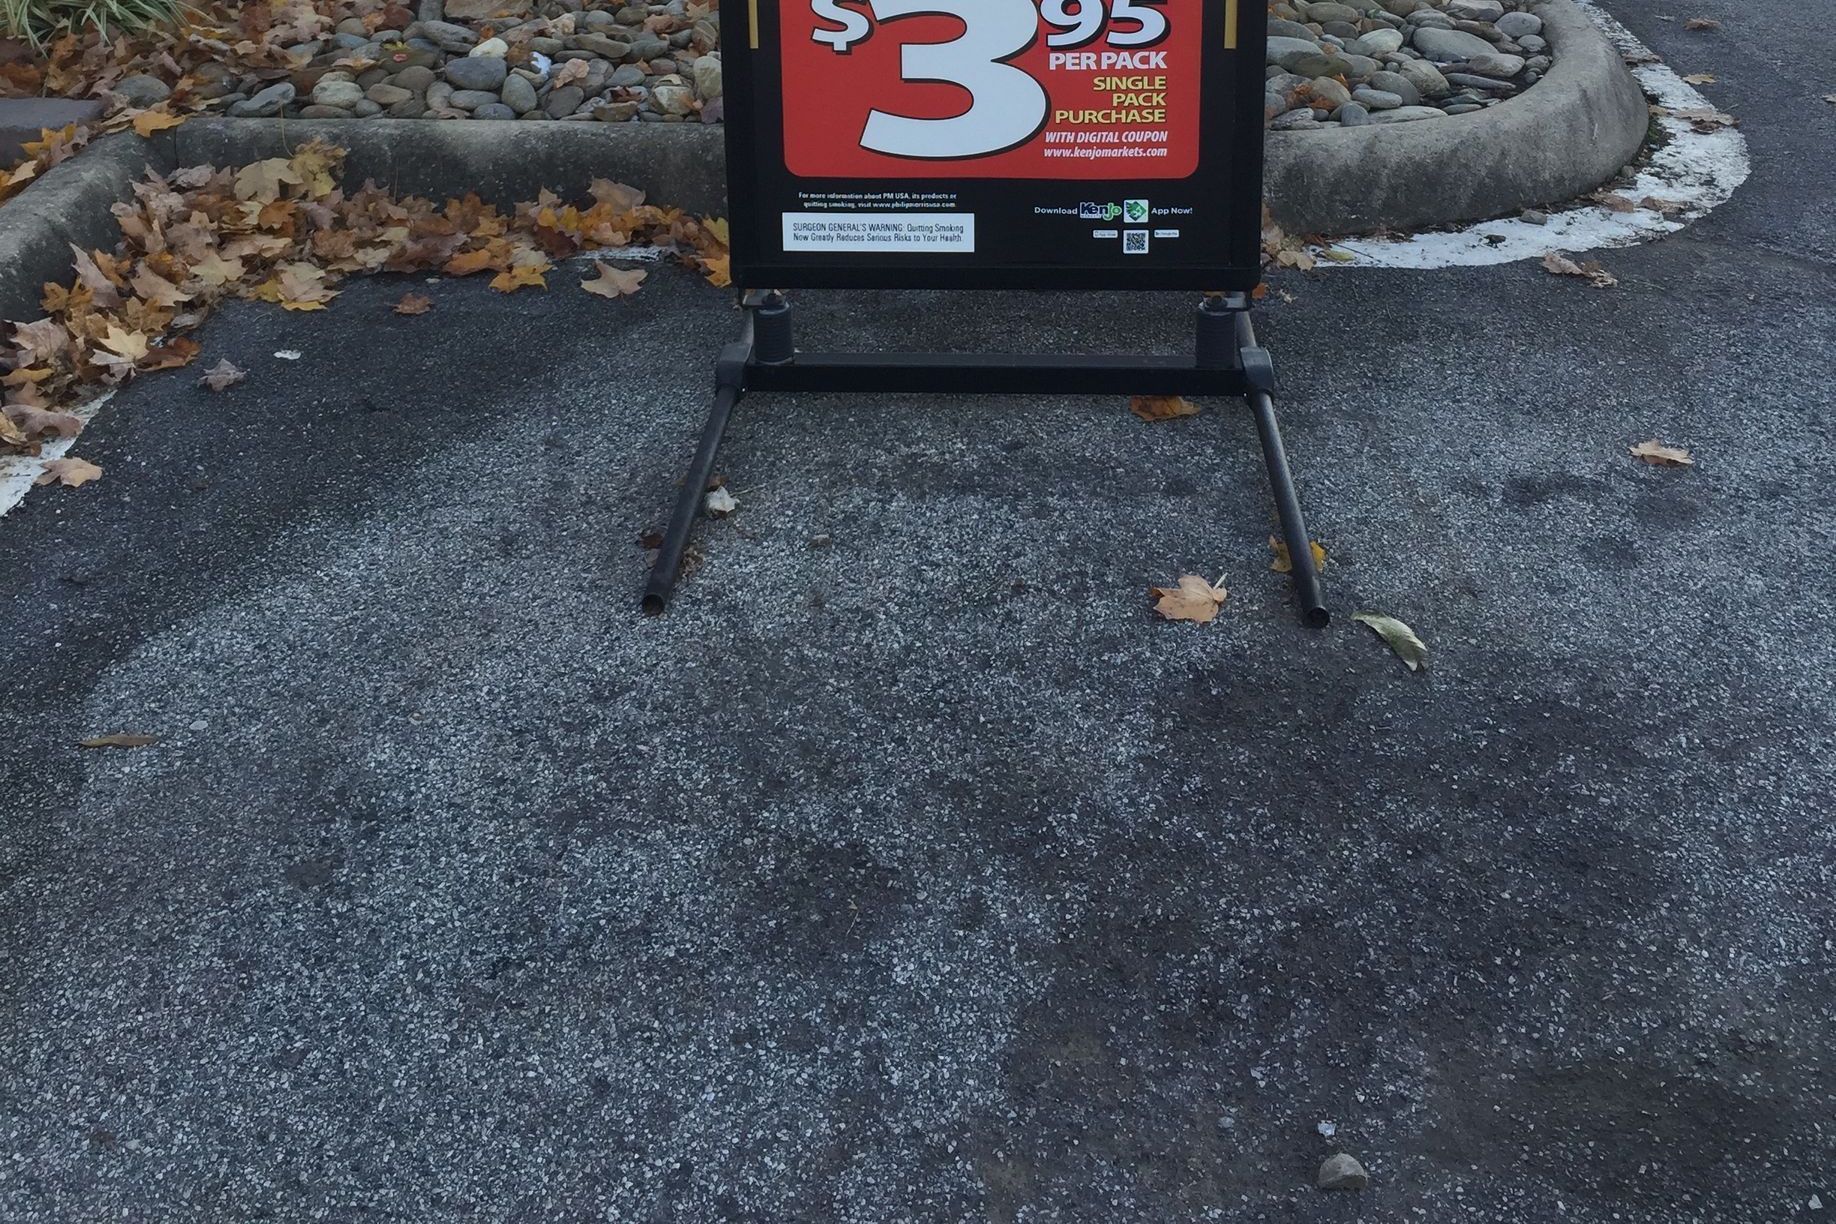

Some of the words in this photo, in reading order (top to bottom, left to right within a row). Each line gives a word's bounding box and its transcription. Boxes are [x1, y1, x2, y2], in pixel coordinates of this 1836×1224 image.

[1048, 52, 1098, 71] PER
[1100, 51, 1168, 70] PACK
[1093, 75, 1167, 91] SINGLE
[1112, 92, 1167, 107] PACK
[1055, 109, 1167, 124] PURCHASE
[1045, 132, 1075, 144] WITH
[1076, 131, 1120, 143] DIGITAL
[1121, 130, 1169, 143] COUPON
[1043, 145, 1168, 160] www.kenjomarkets.com
[1034, 206, 1078, 215] Download
[1080, 202, 1122, 221] Kenjo
[1151, 206, 1170, 216] App
[1171, 206, 1193, 215] Now!
[792, 222, 827, 232] SURGEON
[828, 222, 867, 232] GENERAL'S
[934, 223, 964, 234] Smoking
[793, 232, 809, 242] Now
[810, 232, 835, 243] Greatly
[836, 232, 865, 242] Reduces
[866, 233, 892, 242] Serious
[893, 233, 912, 242] Risks
[913, 233, 921, 242] to
[922, 233, 938, 243] Your
